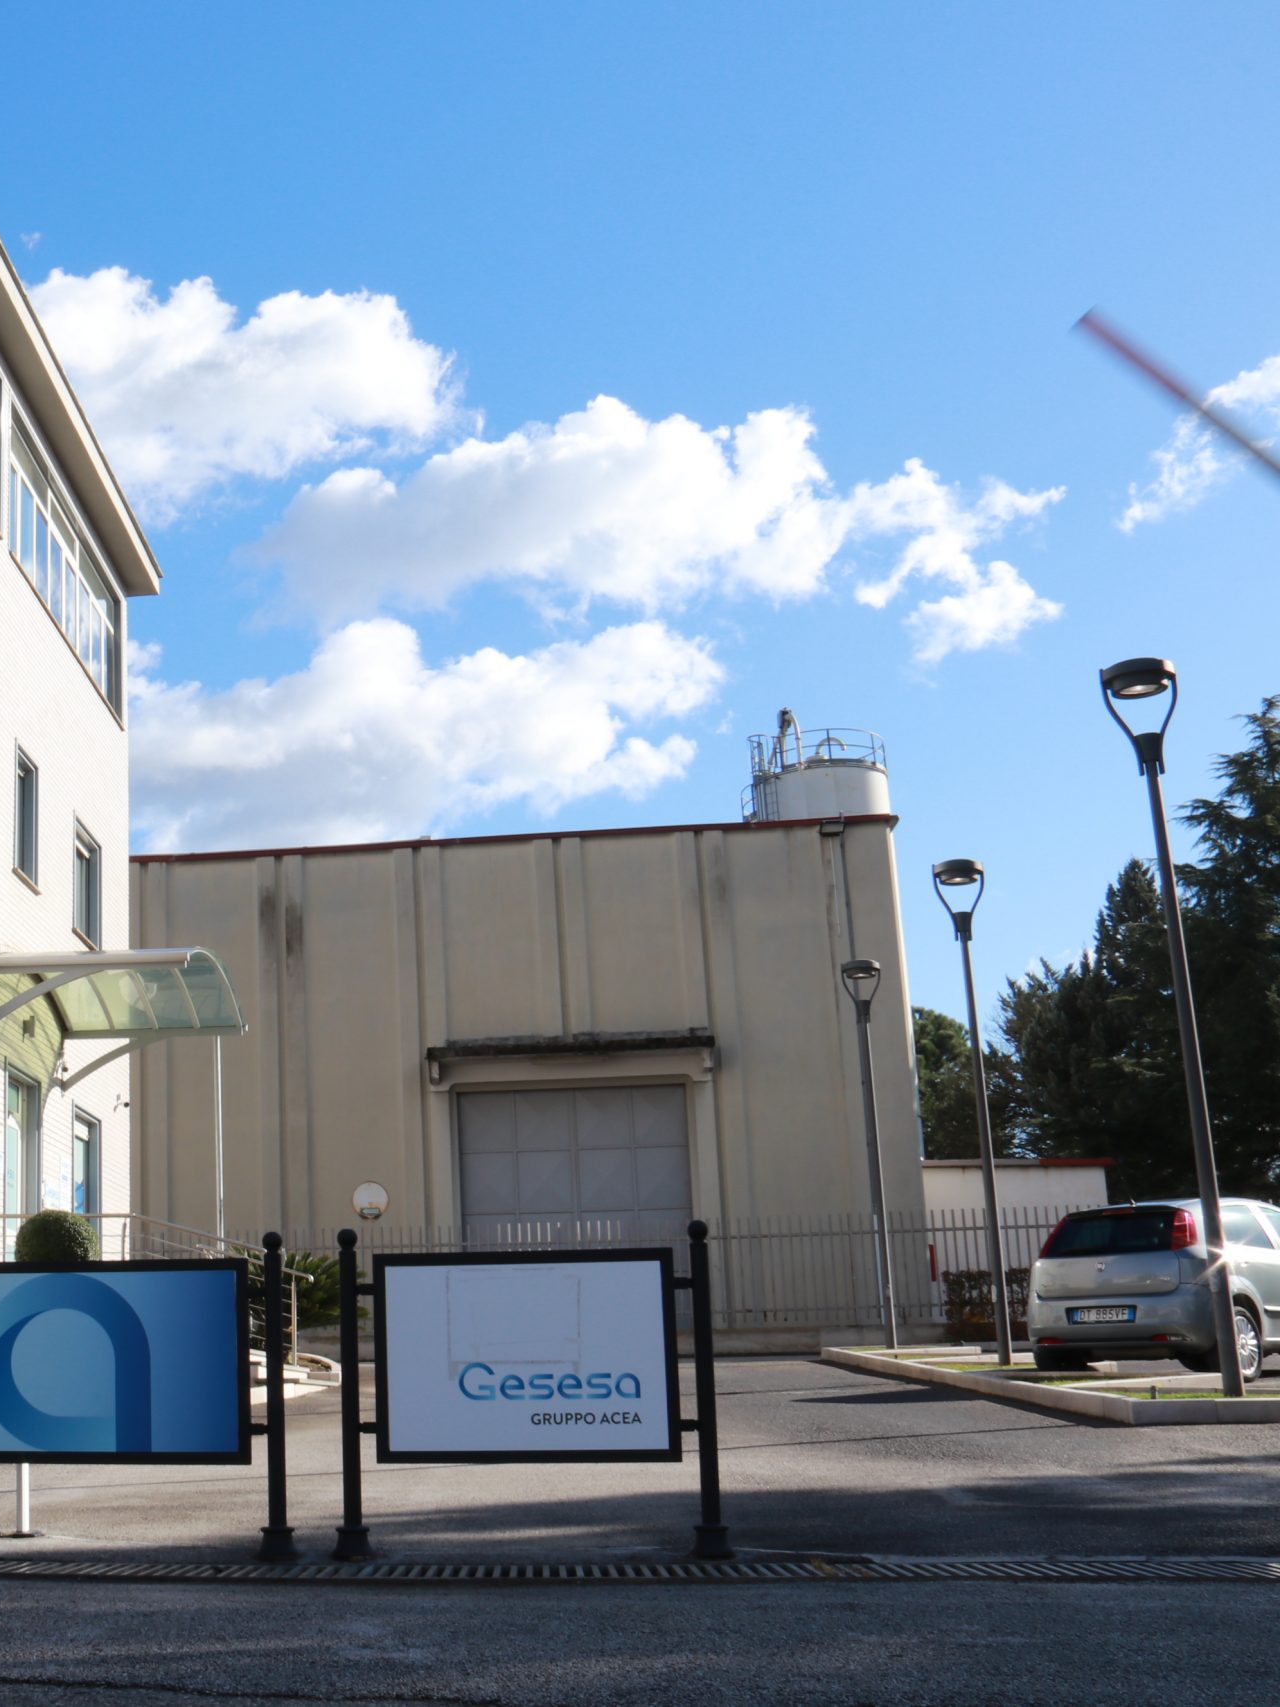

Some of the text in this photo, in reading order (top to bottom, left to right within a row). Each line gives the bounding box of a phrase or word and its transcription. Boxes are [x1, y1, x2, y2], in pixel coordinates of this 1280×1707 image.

[458, 1361, 642, 1401] Gesesa
[531, 1411, 643, 1426] GRUPPO ACEA
